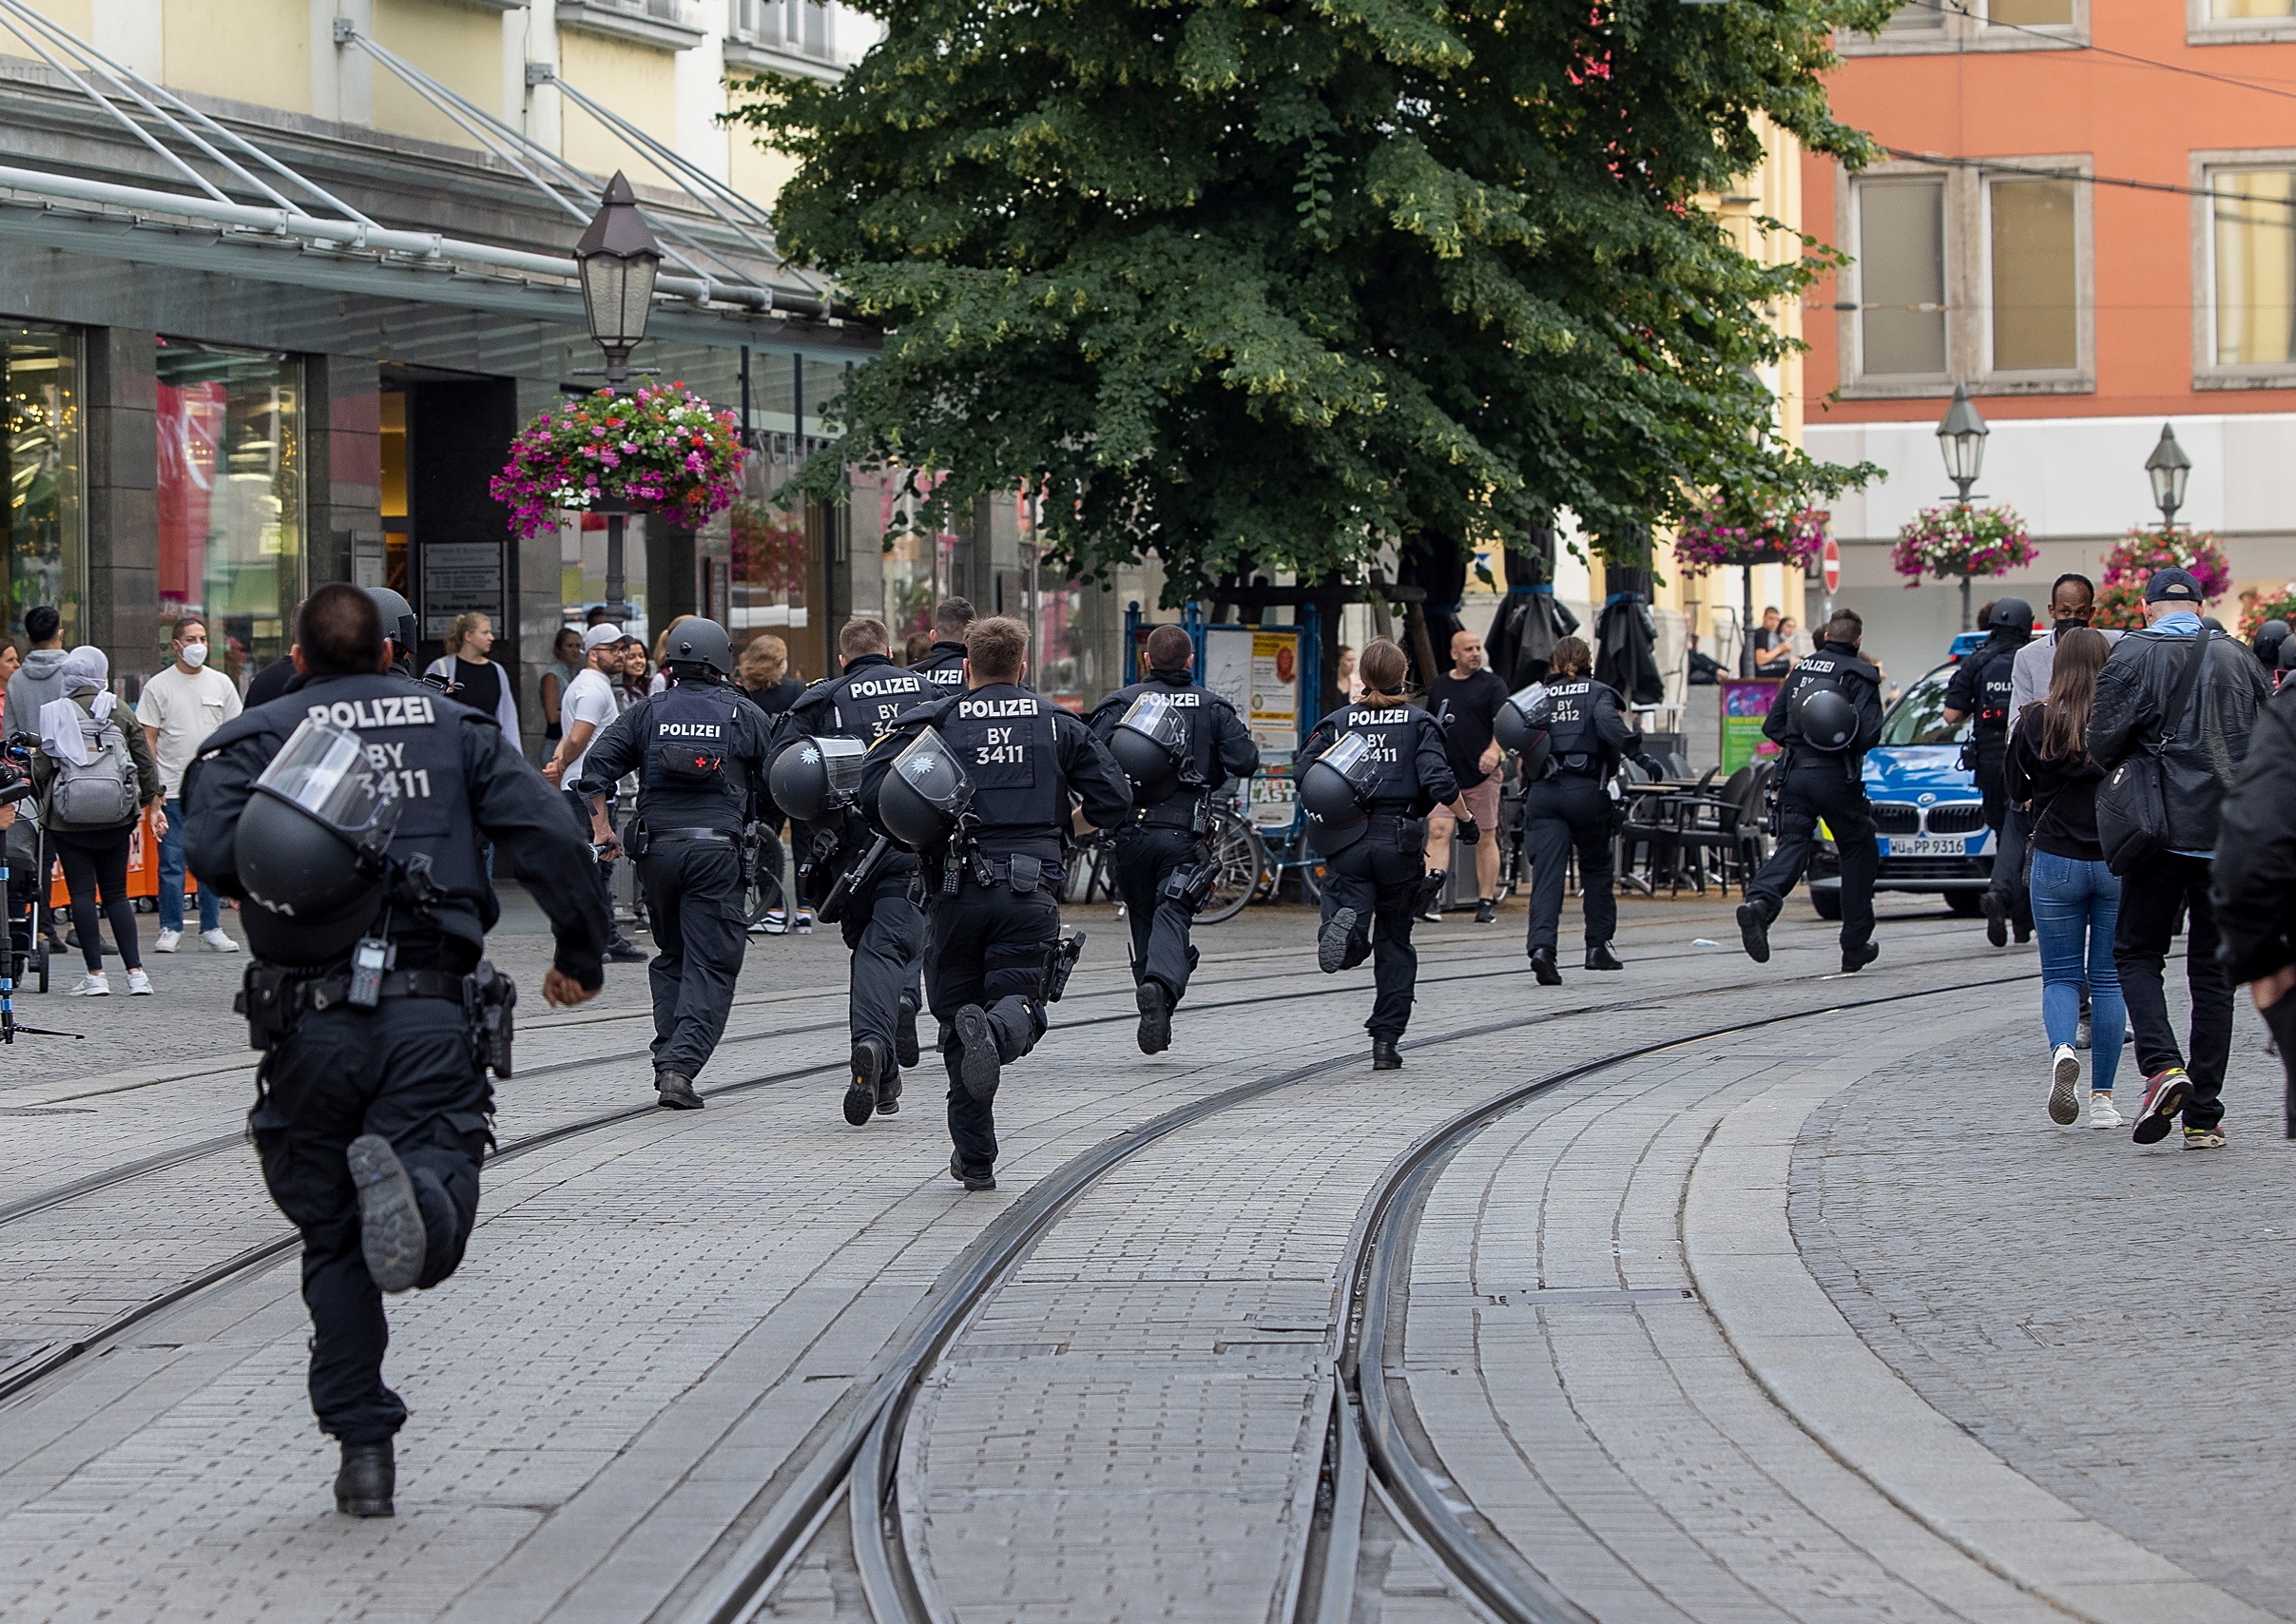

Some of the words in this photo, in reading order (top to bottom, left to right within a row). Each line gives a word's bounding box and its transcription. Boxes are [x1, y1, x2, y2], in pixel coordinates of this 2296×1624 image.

[1795, 659, 1835, 673] POLIZEI
[850, 677, 920, 698] POLIZEI
[1544, 683, 1590, 696] POLIZEI
[1986, 682, 2014, 691] POLI
[1140, 693, 1200, 706] POLIZEI
[1557, 699, 1573, 711] BY
[307, 695, 436, 730] POLIZEI
[878, 704, 899, 720] BY
[958, 698, 1039, 719] POLIZEI
[1348, 709, 1409, 726] POLIZEI
[1551, 710, 1580, 723] 3412
[659, 723, 721, 738] POLIZEI
[987, 726, 1013, 744] BY
[1367, 733, 1386, 748] BY
[366, 742, 405, 770] BY
[976, 744, 1024, 765] 3411
[356, 768, 431, 800] 3411
[1249, 788, 1296, 803] LAST
[1914, 840, 1930, 854] PP
[1933, 840, 1964, 854] 9316
